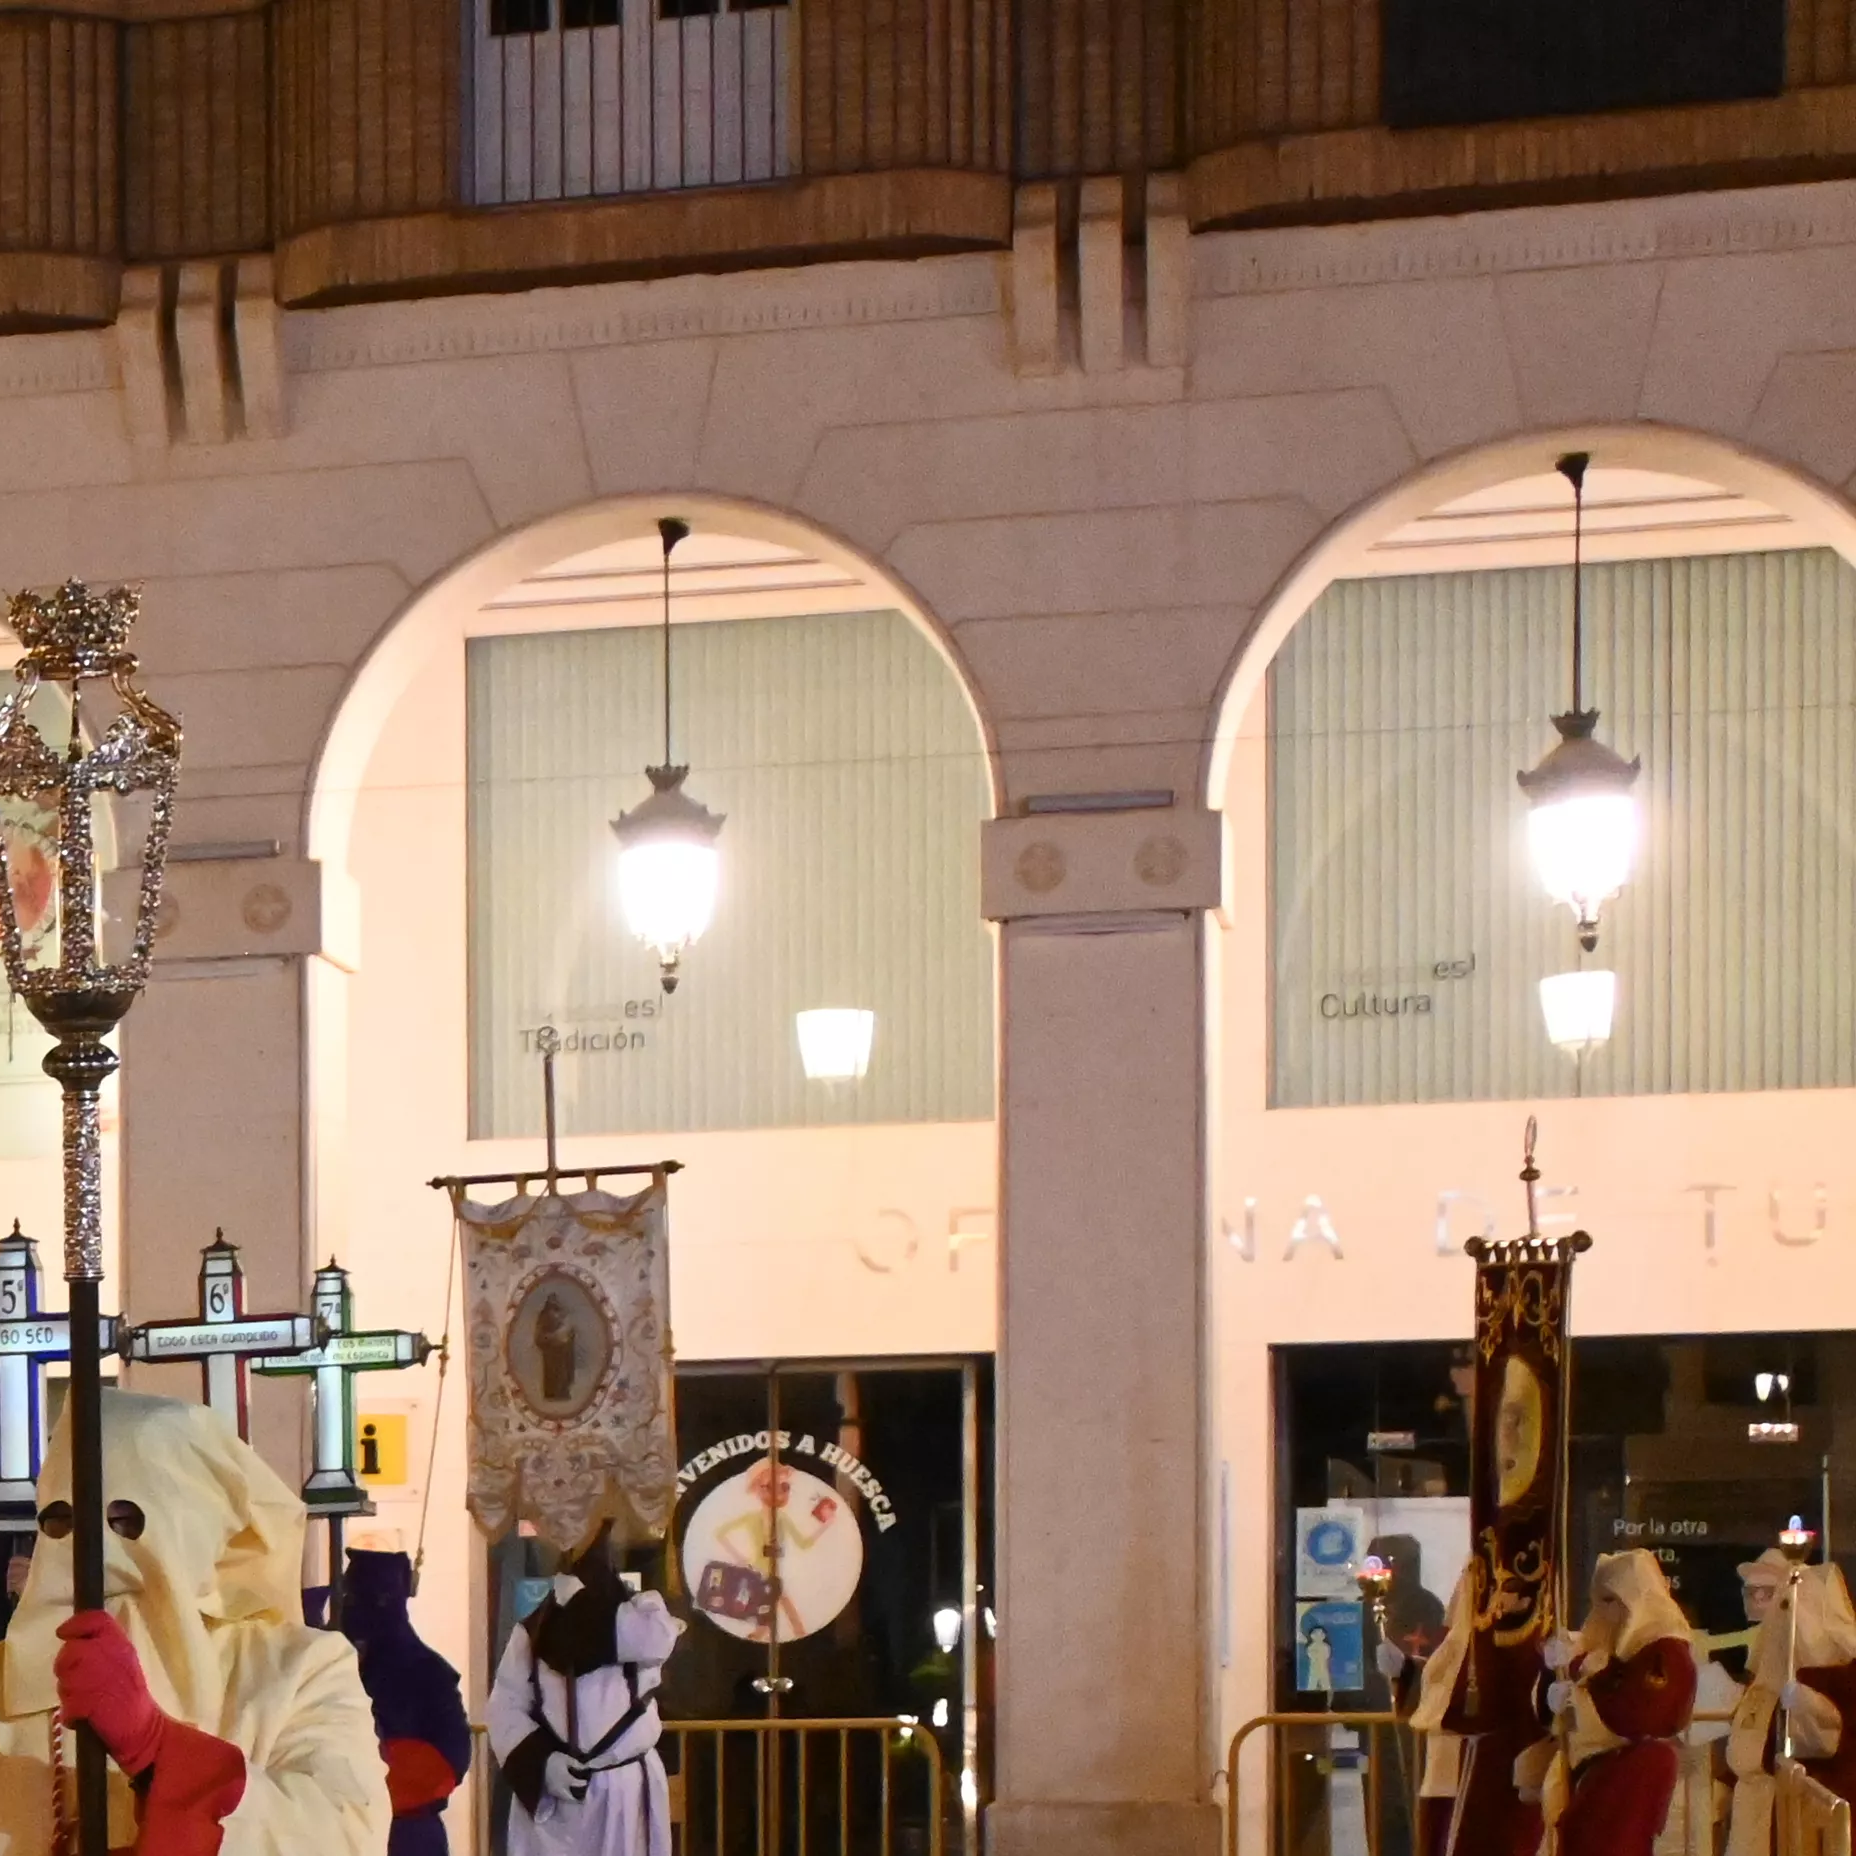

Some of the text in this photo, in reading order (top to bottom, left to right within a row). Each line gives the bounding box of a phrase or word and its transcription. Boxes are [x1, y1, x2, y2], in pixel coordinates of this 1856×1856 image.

[1321, 993, 1432, 1018] Cultura
[519, 1025, 646, 1054] Tdición
[26, 1326, 54, 1344] SED
[676, 1430, 897, 1533] VENIDOS A HUESCA
[1613, 1517, 1708, 1536] Por la otra
